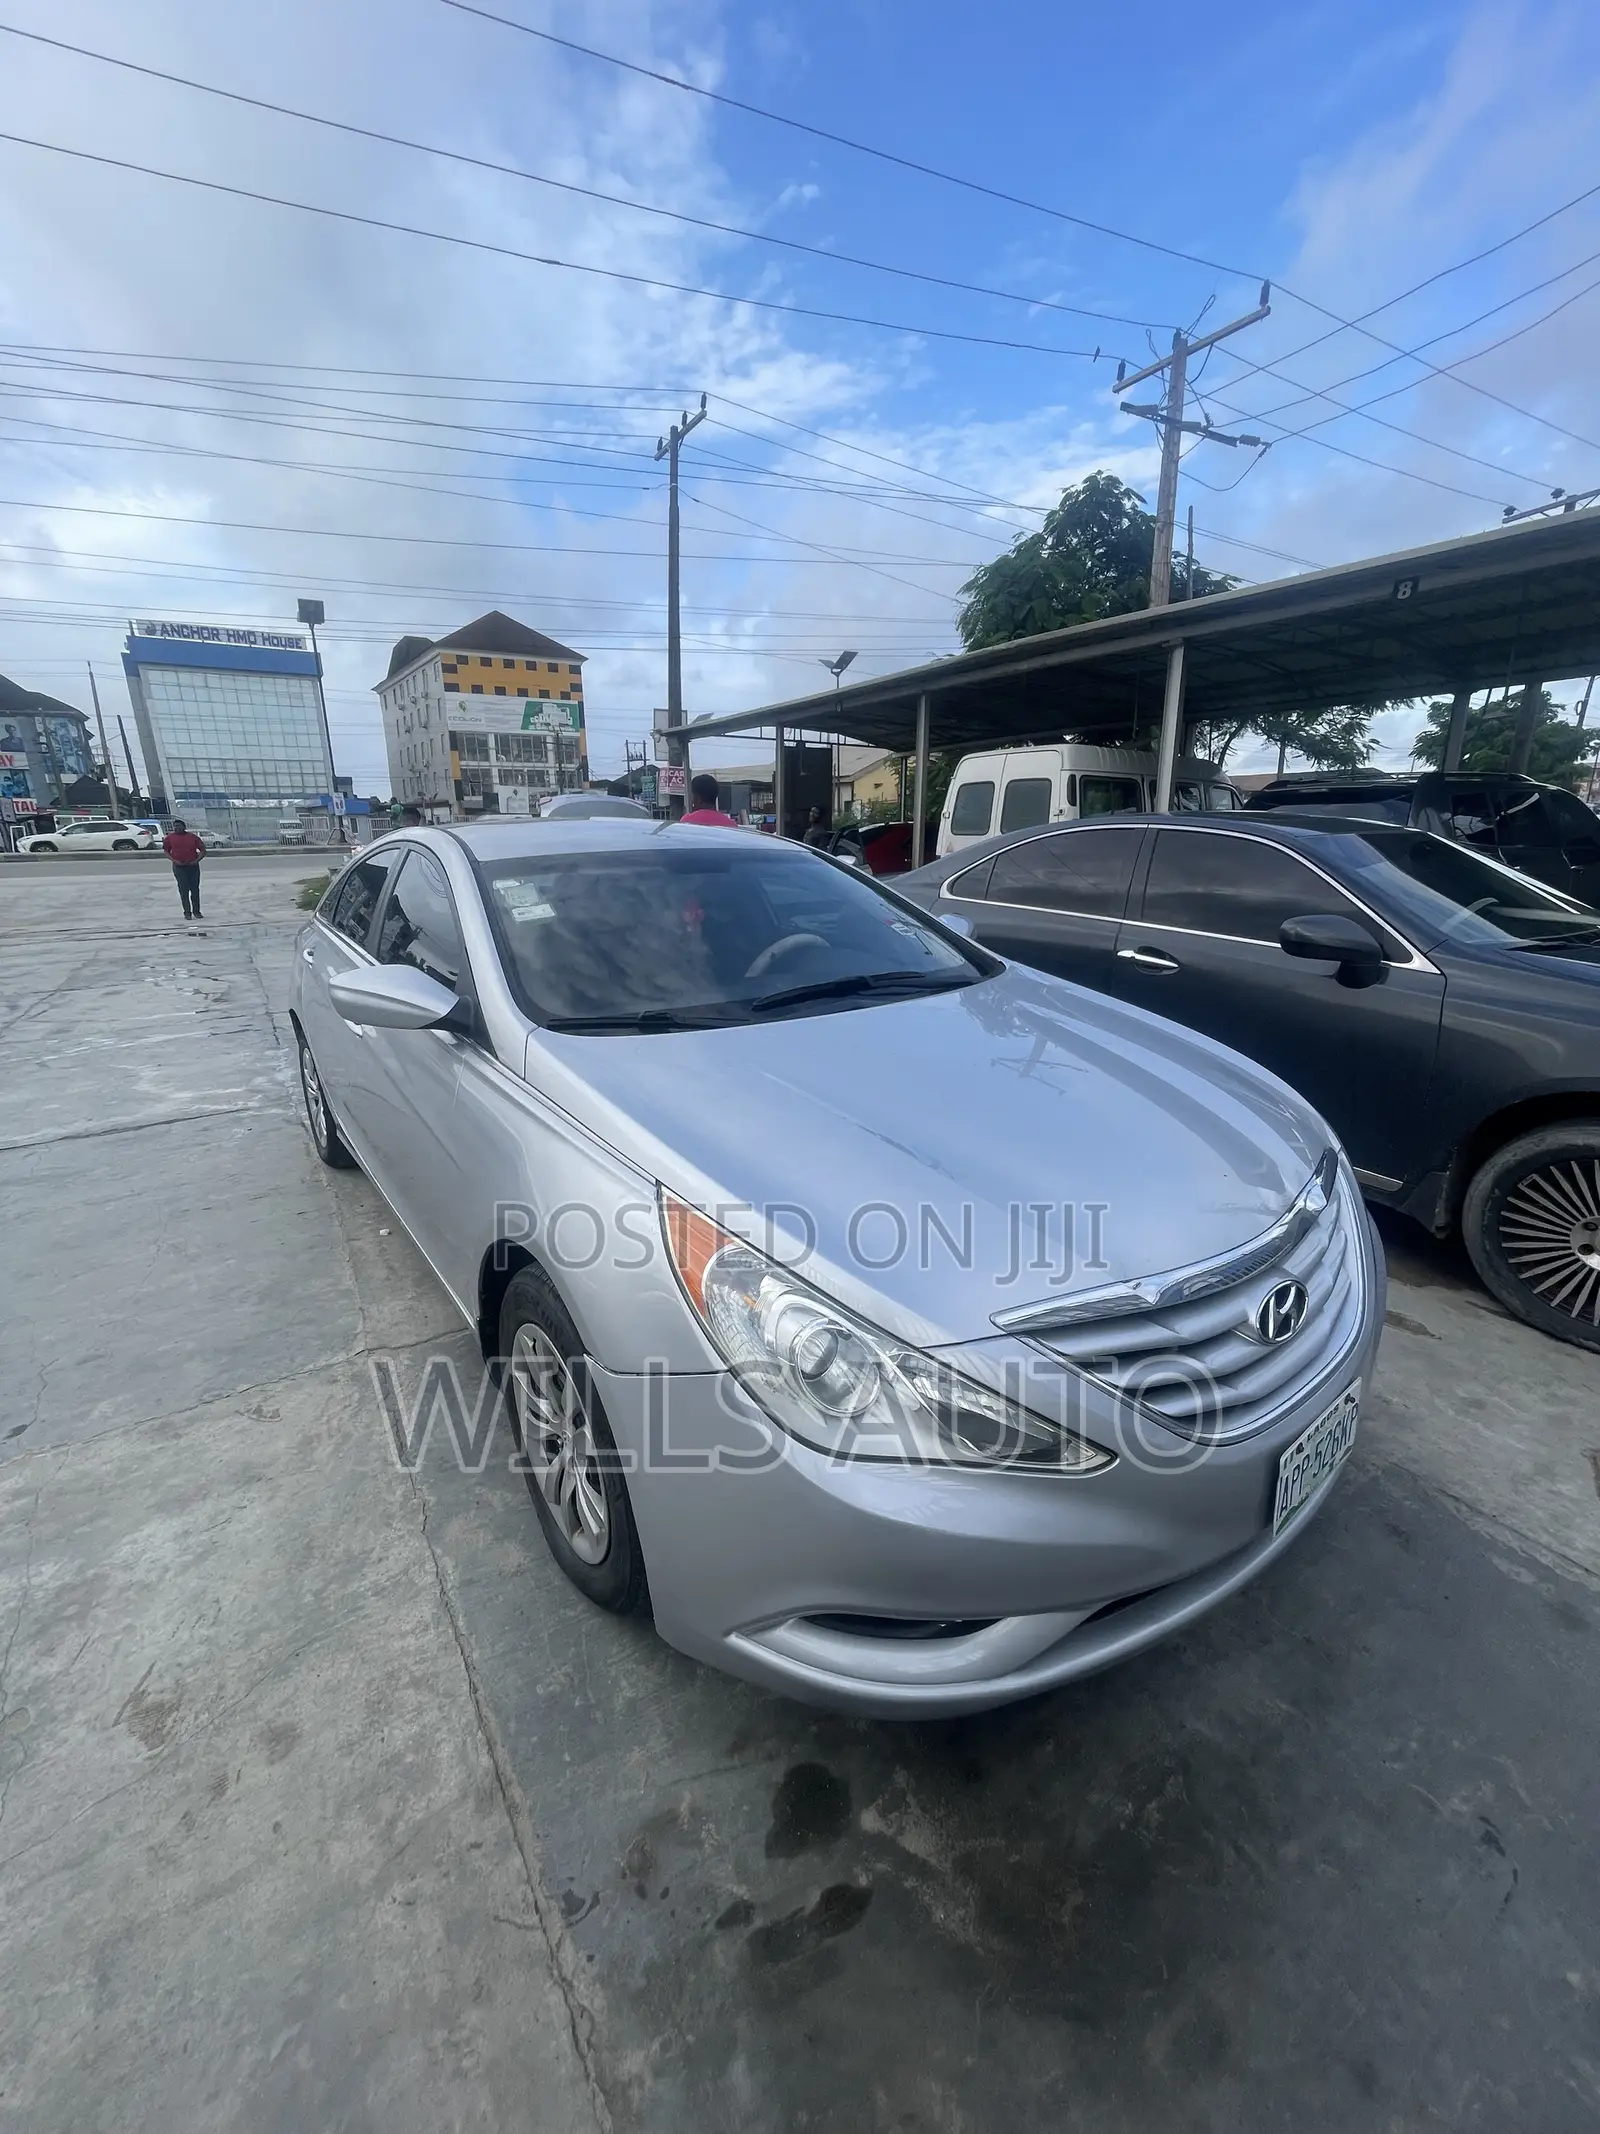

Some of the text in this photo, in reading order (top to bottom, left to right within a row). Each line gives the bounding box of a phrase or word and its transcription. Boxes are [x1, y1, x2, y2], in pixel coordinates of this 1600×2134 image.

[1397, 581, 1413, 600] 8
[160, 622, 303, 650] ANCHOR HMO HOUSE
[1306, 1403, 1340, 1443] LAGOS
